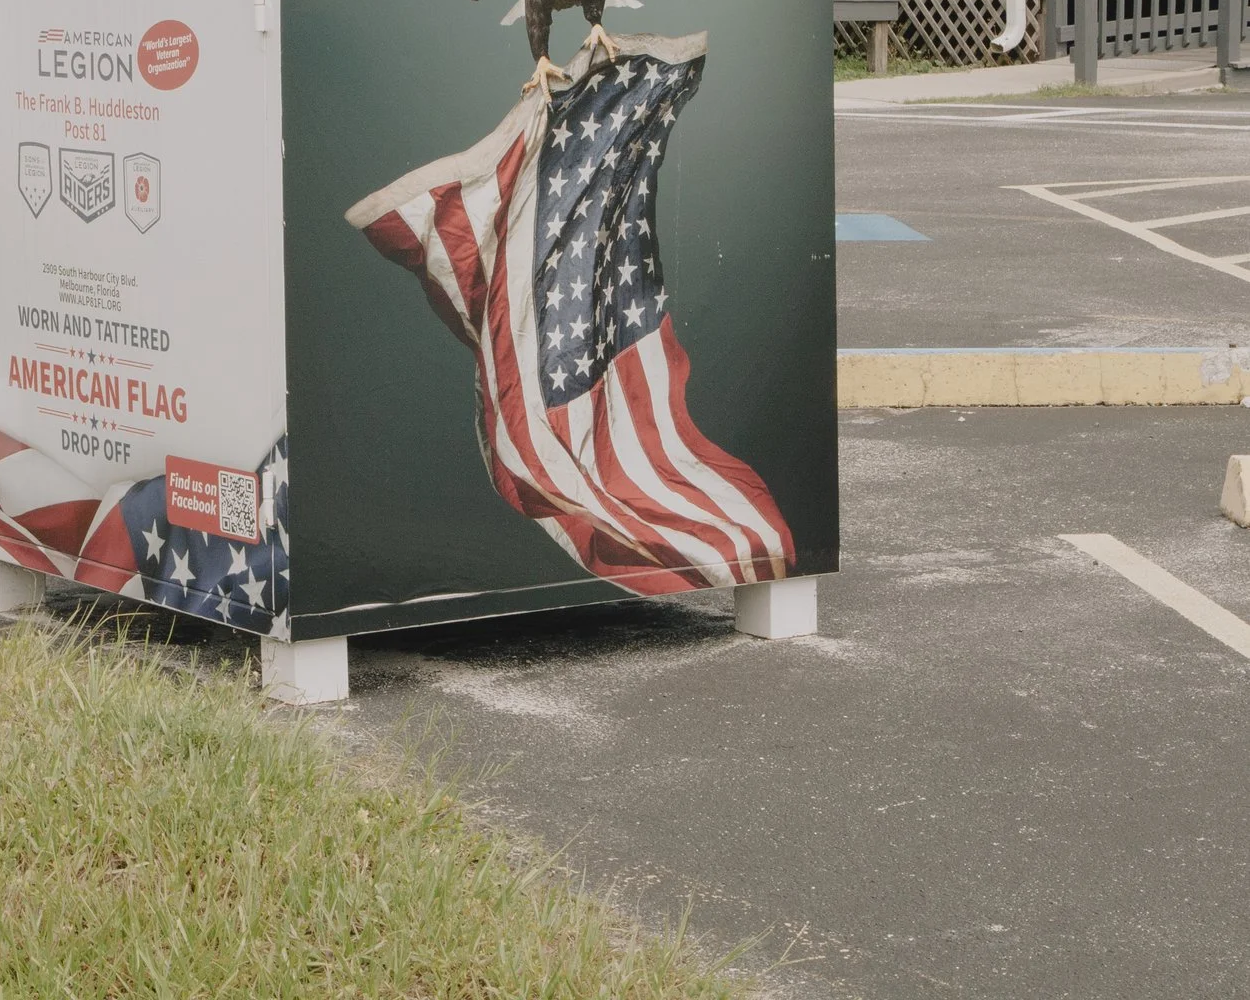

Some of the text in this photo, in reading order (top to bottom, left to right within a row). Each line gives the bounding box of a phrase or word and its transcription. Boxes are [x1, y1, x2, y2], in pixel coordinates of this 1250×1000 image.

[63, 31, 133, 47] AMERICAN
[169, 33, 193, 48] Largest
[38, 49, 133, 83] LEGION
[156, 48, 180, 61] Veteran
[15, 91, 160, 121] The Frank B. Huddleston
[64, 120, 107, 142] Post 81
[24, 168, 46, 177] LEGION
[74, 161, 99, 170] LEGION
[63, 172, 111, 211] RIDERS
[42, 263, 138, 288] 2909 South Harbour City Blvd.
[59, 279, 120, 298] Melbourne, Florida
[18, 305, 170, 352] WORN AND TATTERED
[8, 355, 187, 424] AMERICAN FLAG
[61, 428, 131, 465] DROP OFF
[169, 471, 217, 496] Find us on
[171, 491, 217, 517] Facebook
